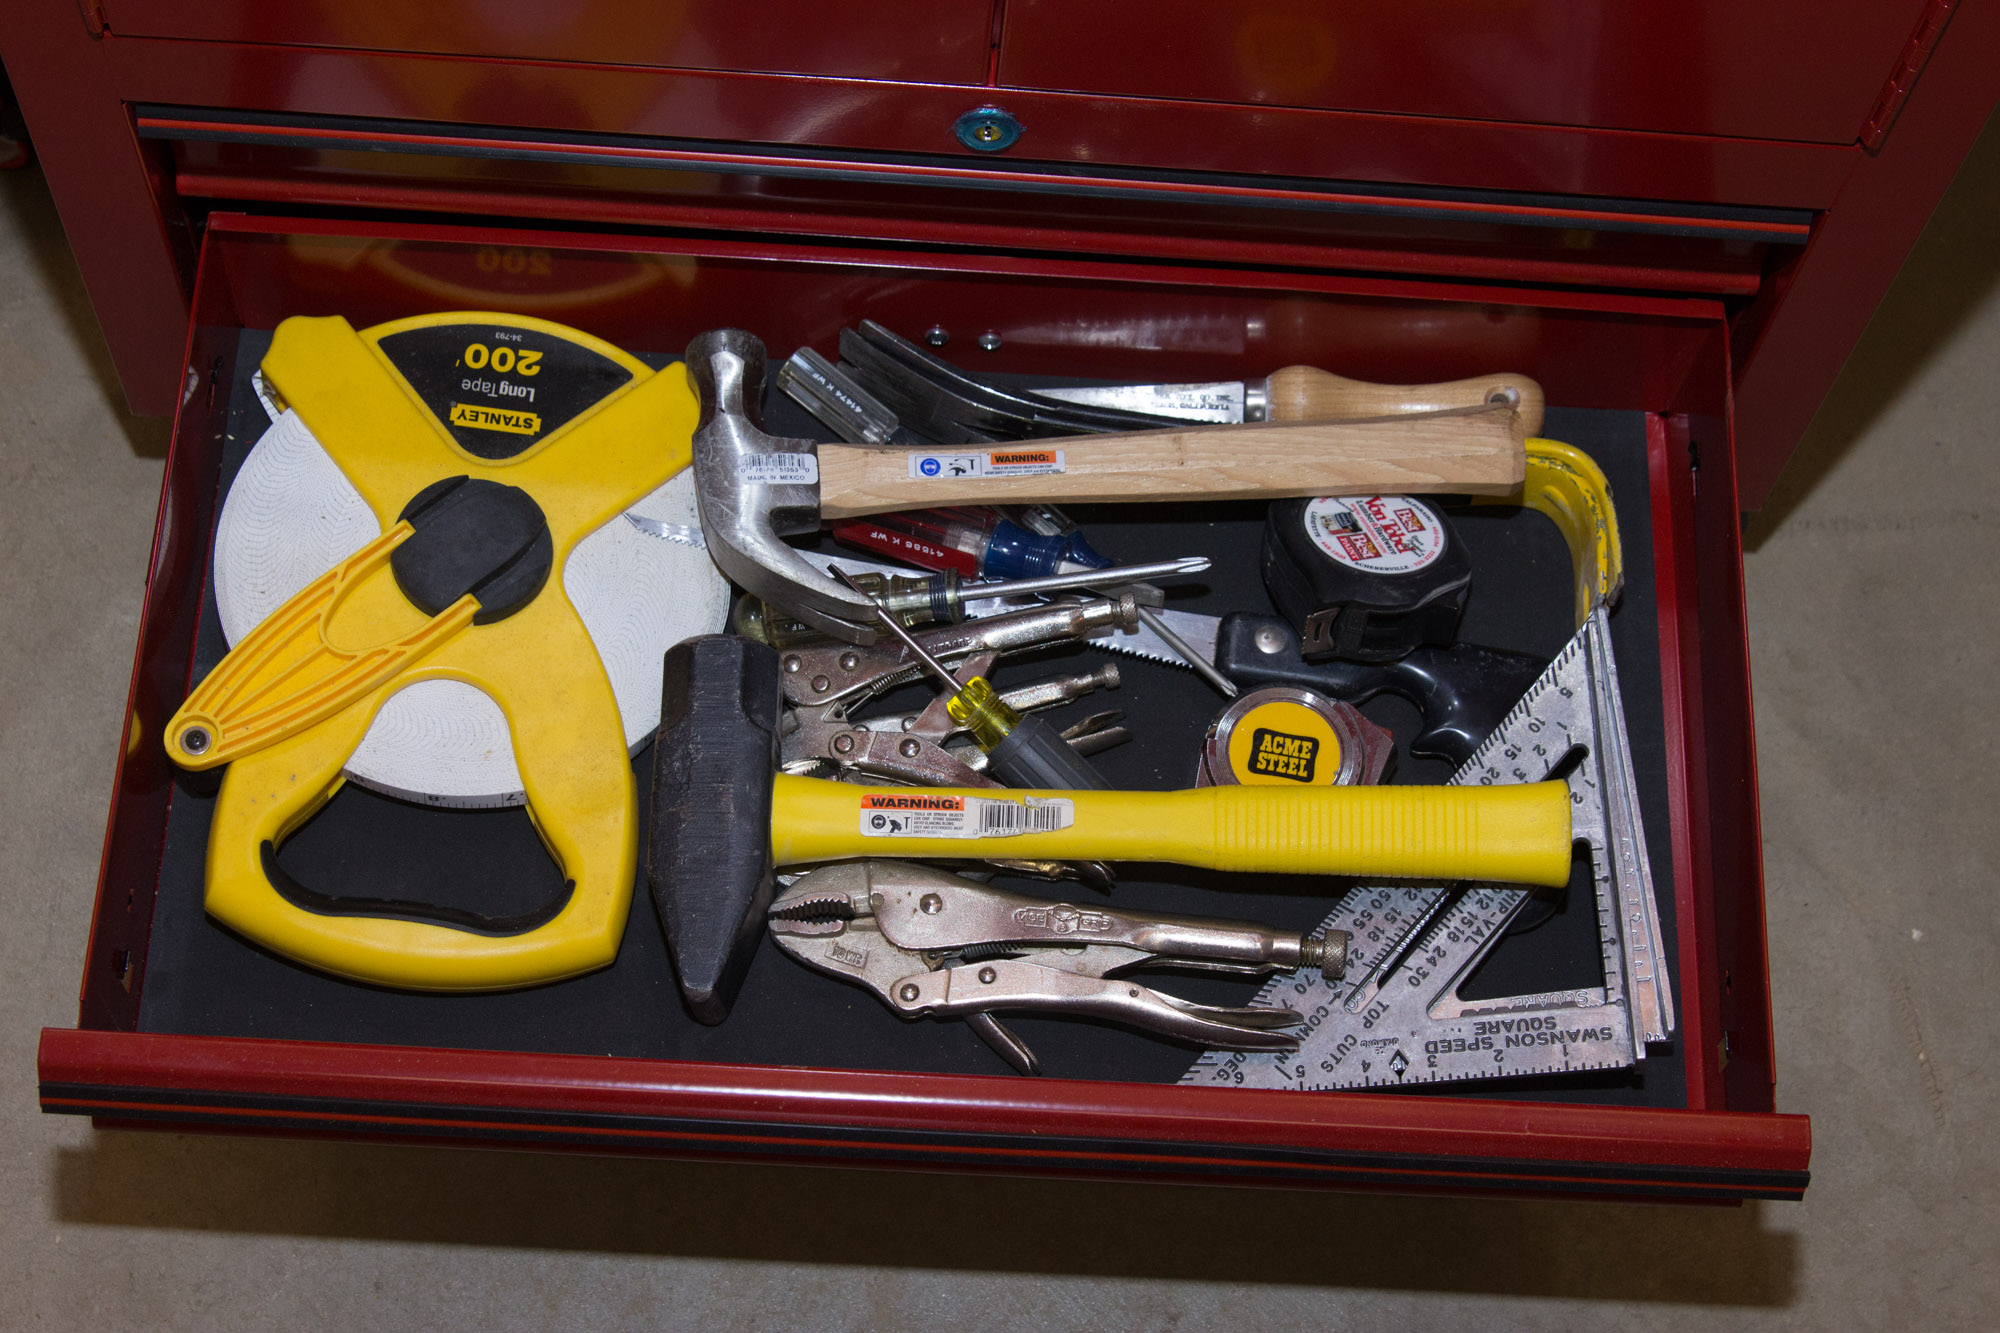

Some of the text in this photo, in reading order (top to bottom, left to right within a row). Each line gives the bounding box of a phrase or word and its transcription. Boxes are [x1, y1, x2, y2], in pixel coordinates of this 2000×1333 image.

[495, 332, 522, 342] 34-793
[826, 382, 834, 391] K
[835, 390, 862, 413] 41474
[456, 408, 535, 429] STANLEY
[994, 454, 1049, 463] WARNING:
[1365, 496, 1387, 521] Von
[1396, 510, 1419, 533] Best
[870, 530, 888, 541] WF
[892, 536, 901, 545] K
[1339, 537, 1361, 560] PAINT
[1349, 535, 1376, 559] Best
[1560, 686, 1574, 699] 5
[1528, 717, 1546, 733] 10
[1260, 734, 1313, 759] ACME
[1504, 743, 1522, 760] 15
[1532, 744, 1547, 756] 2
[1256, 752, 1308, 777] STEEL
[1513, 767, 1527, 780] 3
[1480, 766, 1500, 786] 20
[871, 798, 960, 809] WARNING:
[1370, 889, 1391, 909] 50
[1476, 891, 1494, 911] 12
[1352, 909, 1374, 931] 55
[1384, 906, 1402, 924] 15
[1460, 910, 1478, 929] 15
[1464, 889, 1520, 944] HIP-VAL
[1366, 925, 1385, 943] 18
[1447, 925, 1465, 943] 18
[1345, 947, 1364, 969] 24
[1426, 945, 1447, 967] 24
[1294, 974, 1315, 995] 70
[1407, 966, 1429, 987] 30
[1363, 1000, 1389, 1030] TOP
[1474, 1016, 1556, 1035] SQUARE
[1424, 1026, 1613, 1054] SWANSON SPEED
[1320, 1034, 1358, 1073] CUTS
[1211, 1051, 1247, 1081] DEG.
[1233, 1044, 1570, 1084] 1 2 3 4 5 6
